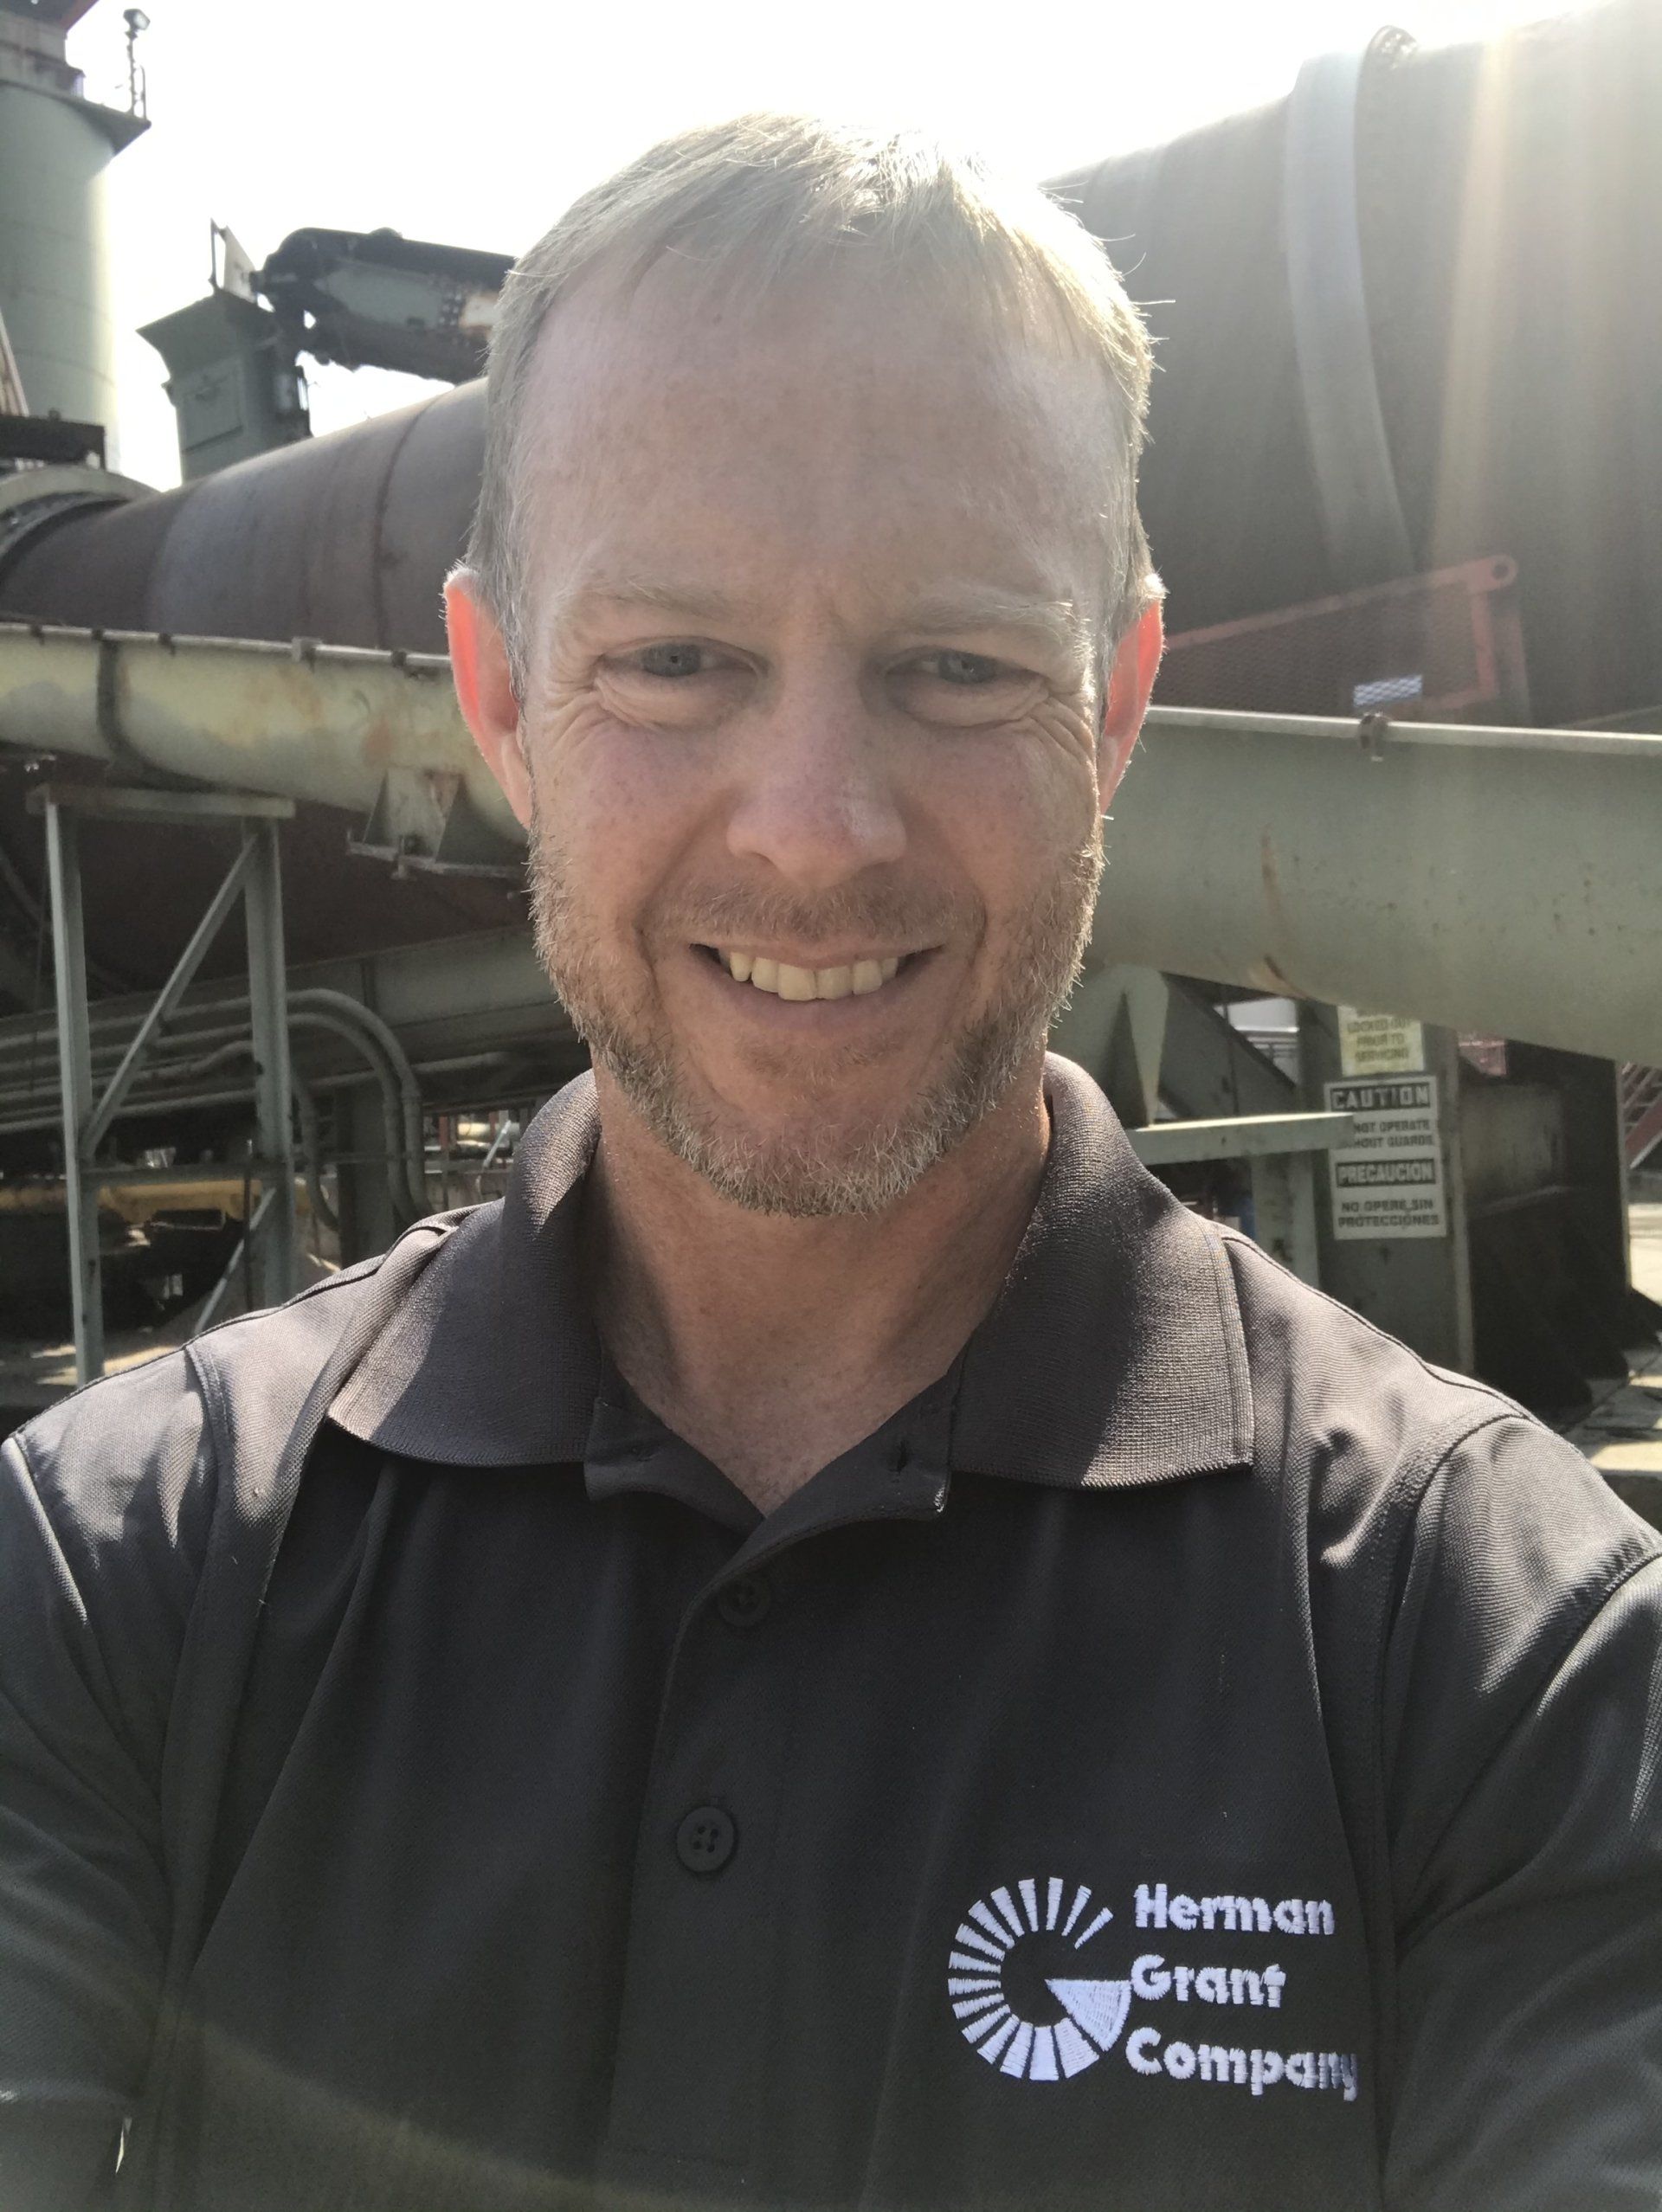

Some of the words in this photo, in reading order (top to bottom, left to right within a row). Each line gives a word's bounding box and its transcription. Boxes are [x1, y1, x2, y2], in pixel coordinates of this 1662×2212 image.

[1332, 1085, 1429, 1109] CAUTION
[1379, 1120, 1430, 1133] OPERATE
[1387, 1135, 1433, 1148] GUARDS
[1342, 1201, 1359, 1212] NO
[1363, 1199, 1407, 1212] OPERE
[1411, 1199, 1434, 1211] SIN
[1133, 1883, 1335, 1935] Herman
[1130, 1953, 1286, 2008] Grant
[1125, 2027, 1357, 2101] Company
